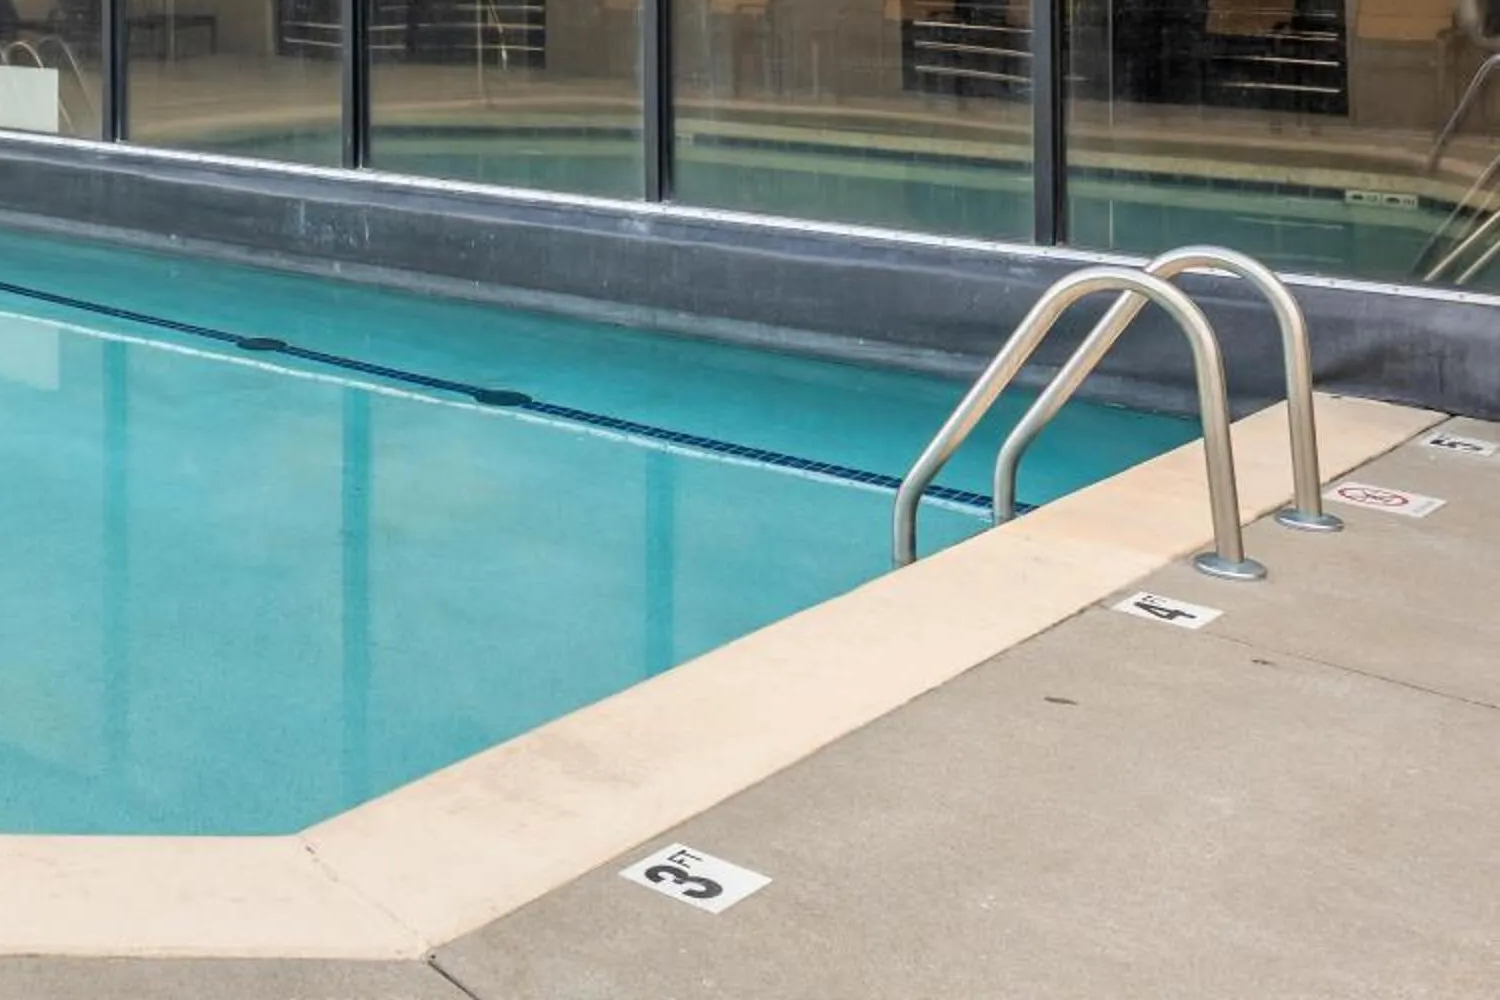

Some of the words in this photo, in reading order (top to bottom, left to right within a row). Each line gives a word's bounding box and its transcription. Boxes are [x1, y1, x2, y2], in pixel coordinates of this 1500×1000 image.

[1133, 602, 1198, 620] 4
[666, 849, 704, 869] FT
[644, 865, 723, 899] 3
